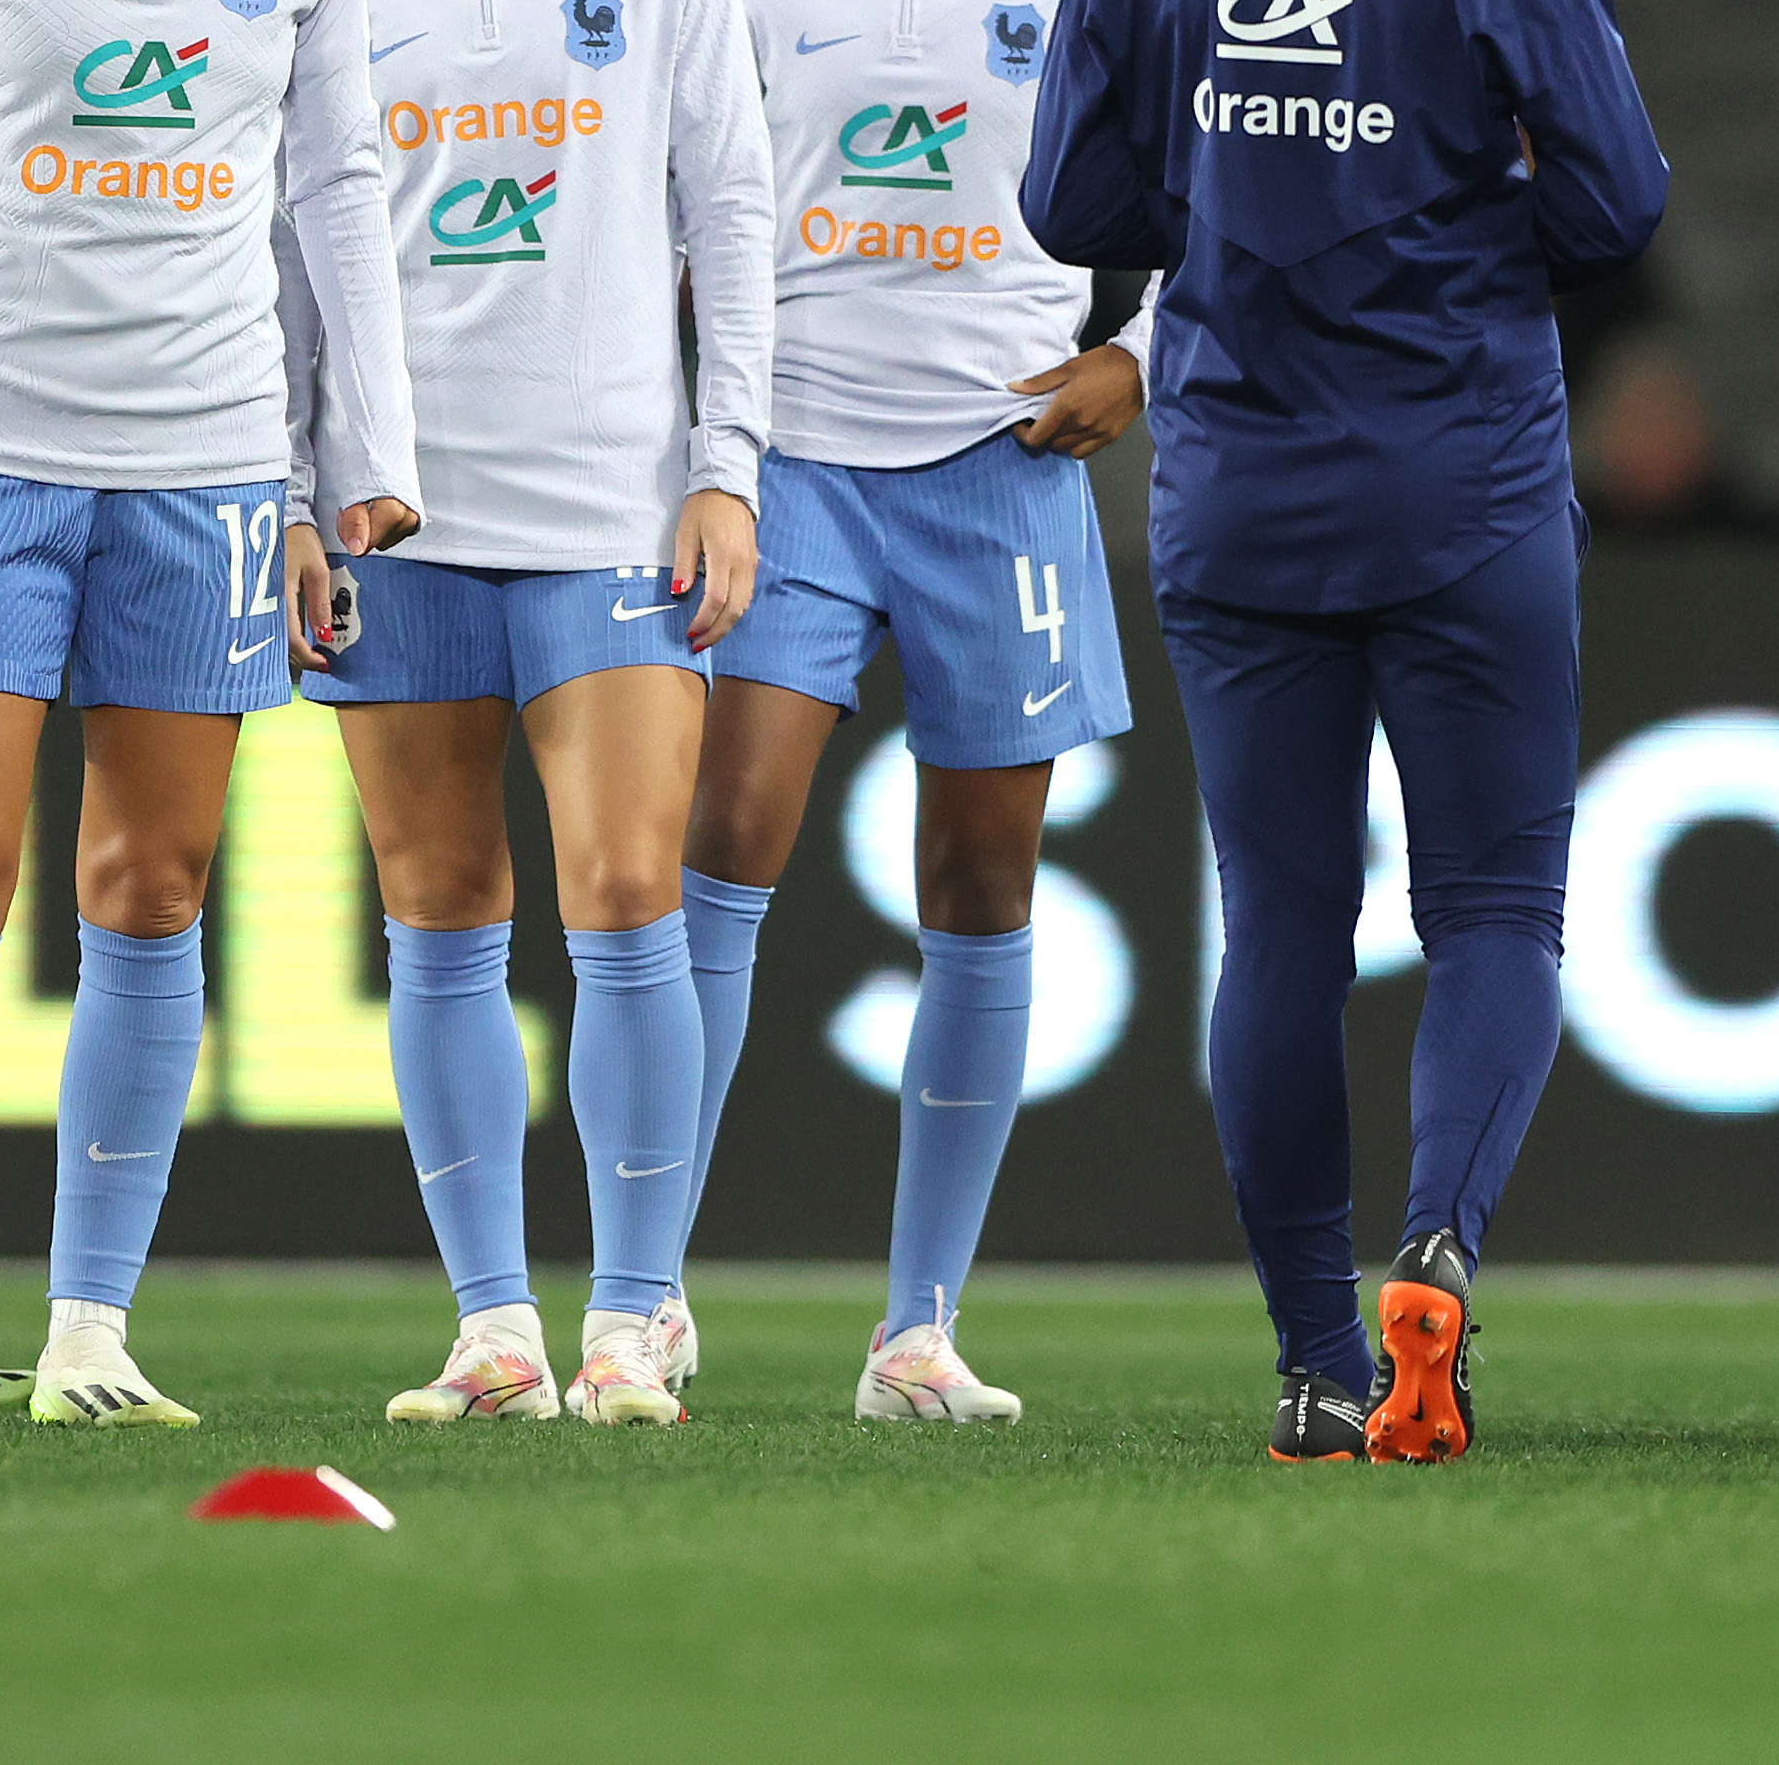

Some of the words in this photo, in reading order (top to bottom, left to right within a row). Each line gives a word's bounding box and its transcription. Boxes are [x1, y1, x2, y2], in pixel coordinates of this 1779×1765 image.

[387, 97, 603, 151] Orange
[1193, 77, 1394, 152] Orange
[21, 144, 234, 212] Orange
[799, 206, 1002, 272] Orange
[216, 499, 278, 619] 12
[1014, 554, 1067, 664] 4
